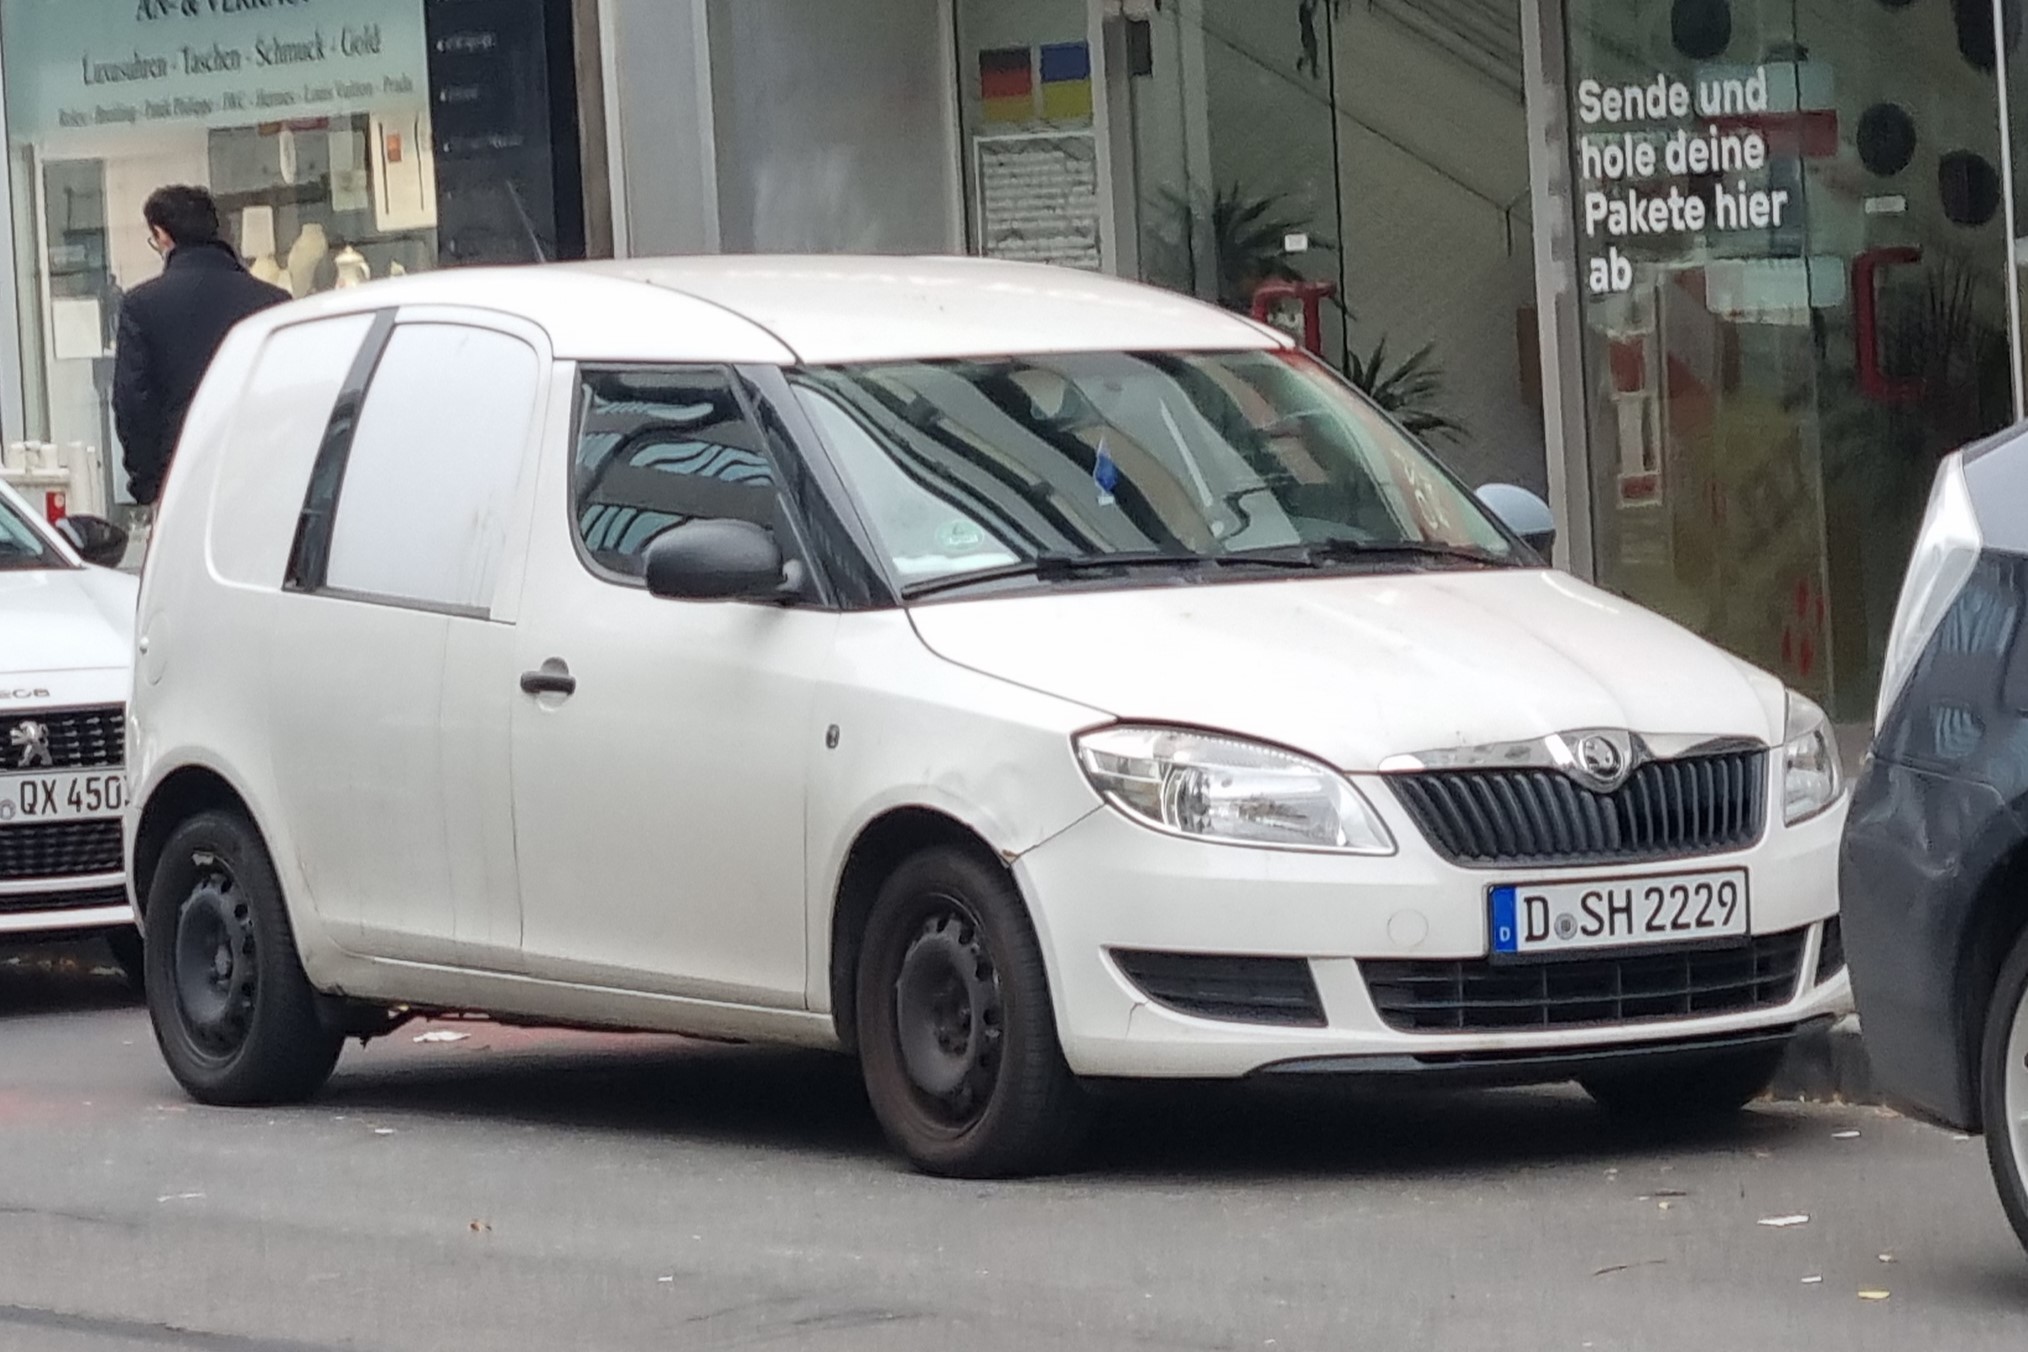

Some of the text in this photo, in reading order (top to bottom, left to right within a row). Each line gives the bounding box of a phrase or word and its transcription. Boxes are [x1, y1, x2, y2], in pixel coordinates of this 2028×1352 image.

[180, 44, 242, 75] Taschen
[255, 28, 325, 67] Schmuck
[341, 23, 382, 57] Gold
[1578, 65, 1768, 123] Sende und
[1581, 124, 1765, 179] hole deine
[1585, 179, 1788, 237] Pakete hier
[1589, 246, 1632, 293] ab
[20, 775, 130, 815] QX 450
[1499, 927, 1510, 942] D
[1523, 880, 1738, 942] D SH 2229
